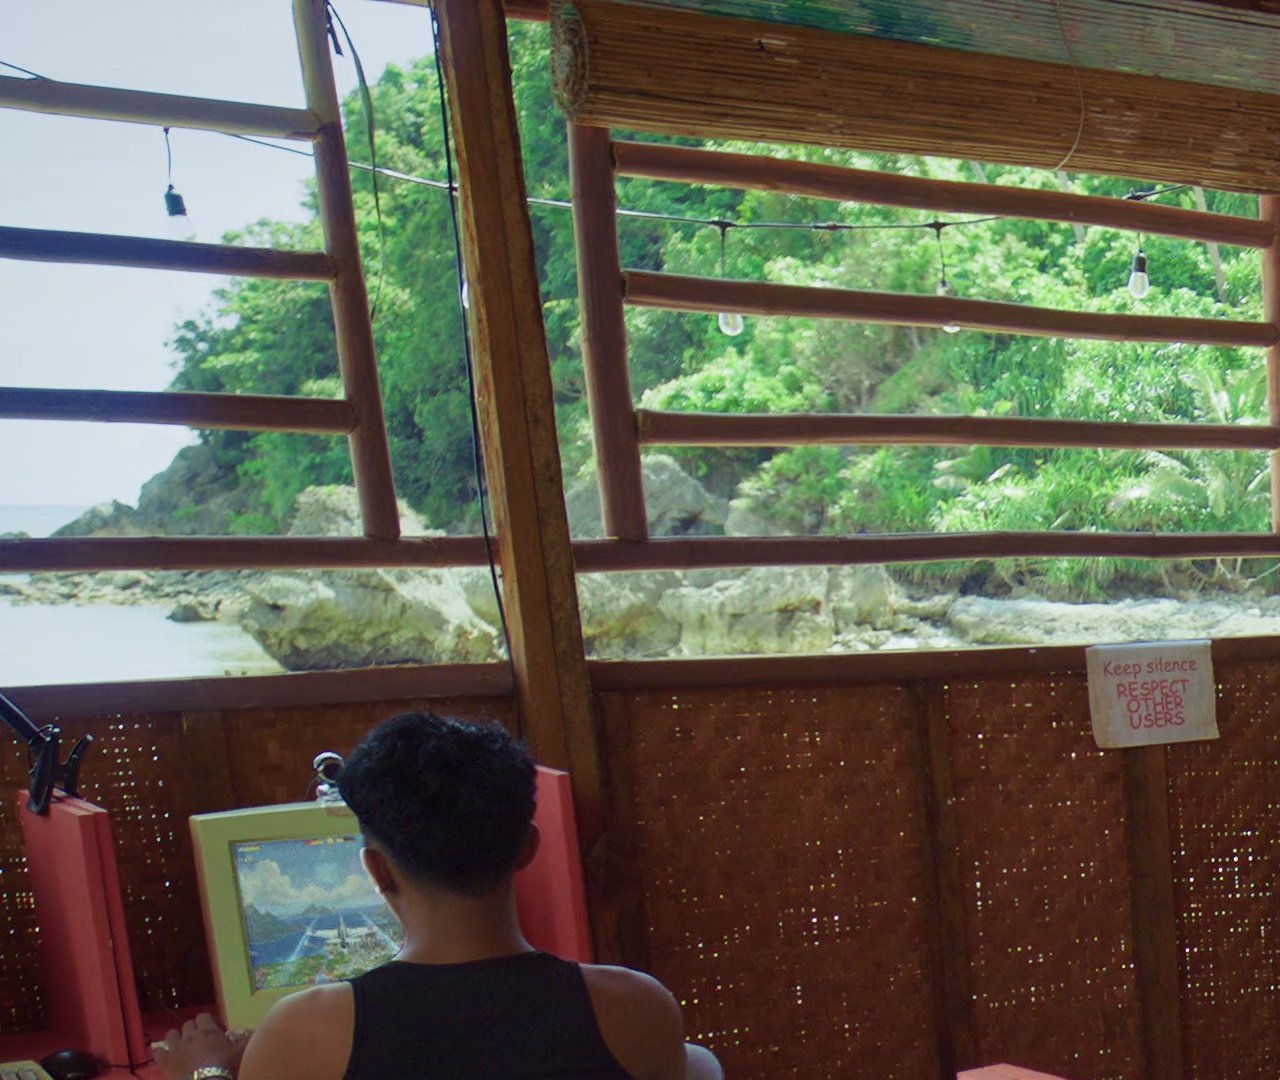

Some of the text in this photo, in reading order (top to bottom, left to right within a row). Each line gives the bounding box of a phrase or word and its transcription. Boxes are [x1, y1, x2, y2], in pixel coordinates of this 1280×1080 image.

[1103, 657, 1198, 678] Keep silence
[1116, 679, 1189, 698] RESPECT
[1127, 696, 1184, 713] OTHER
[1130, 711, 1185, 729] USERS
